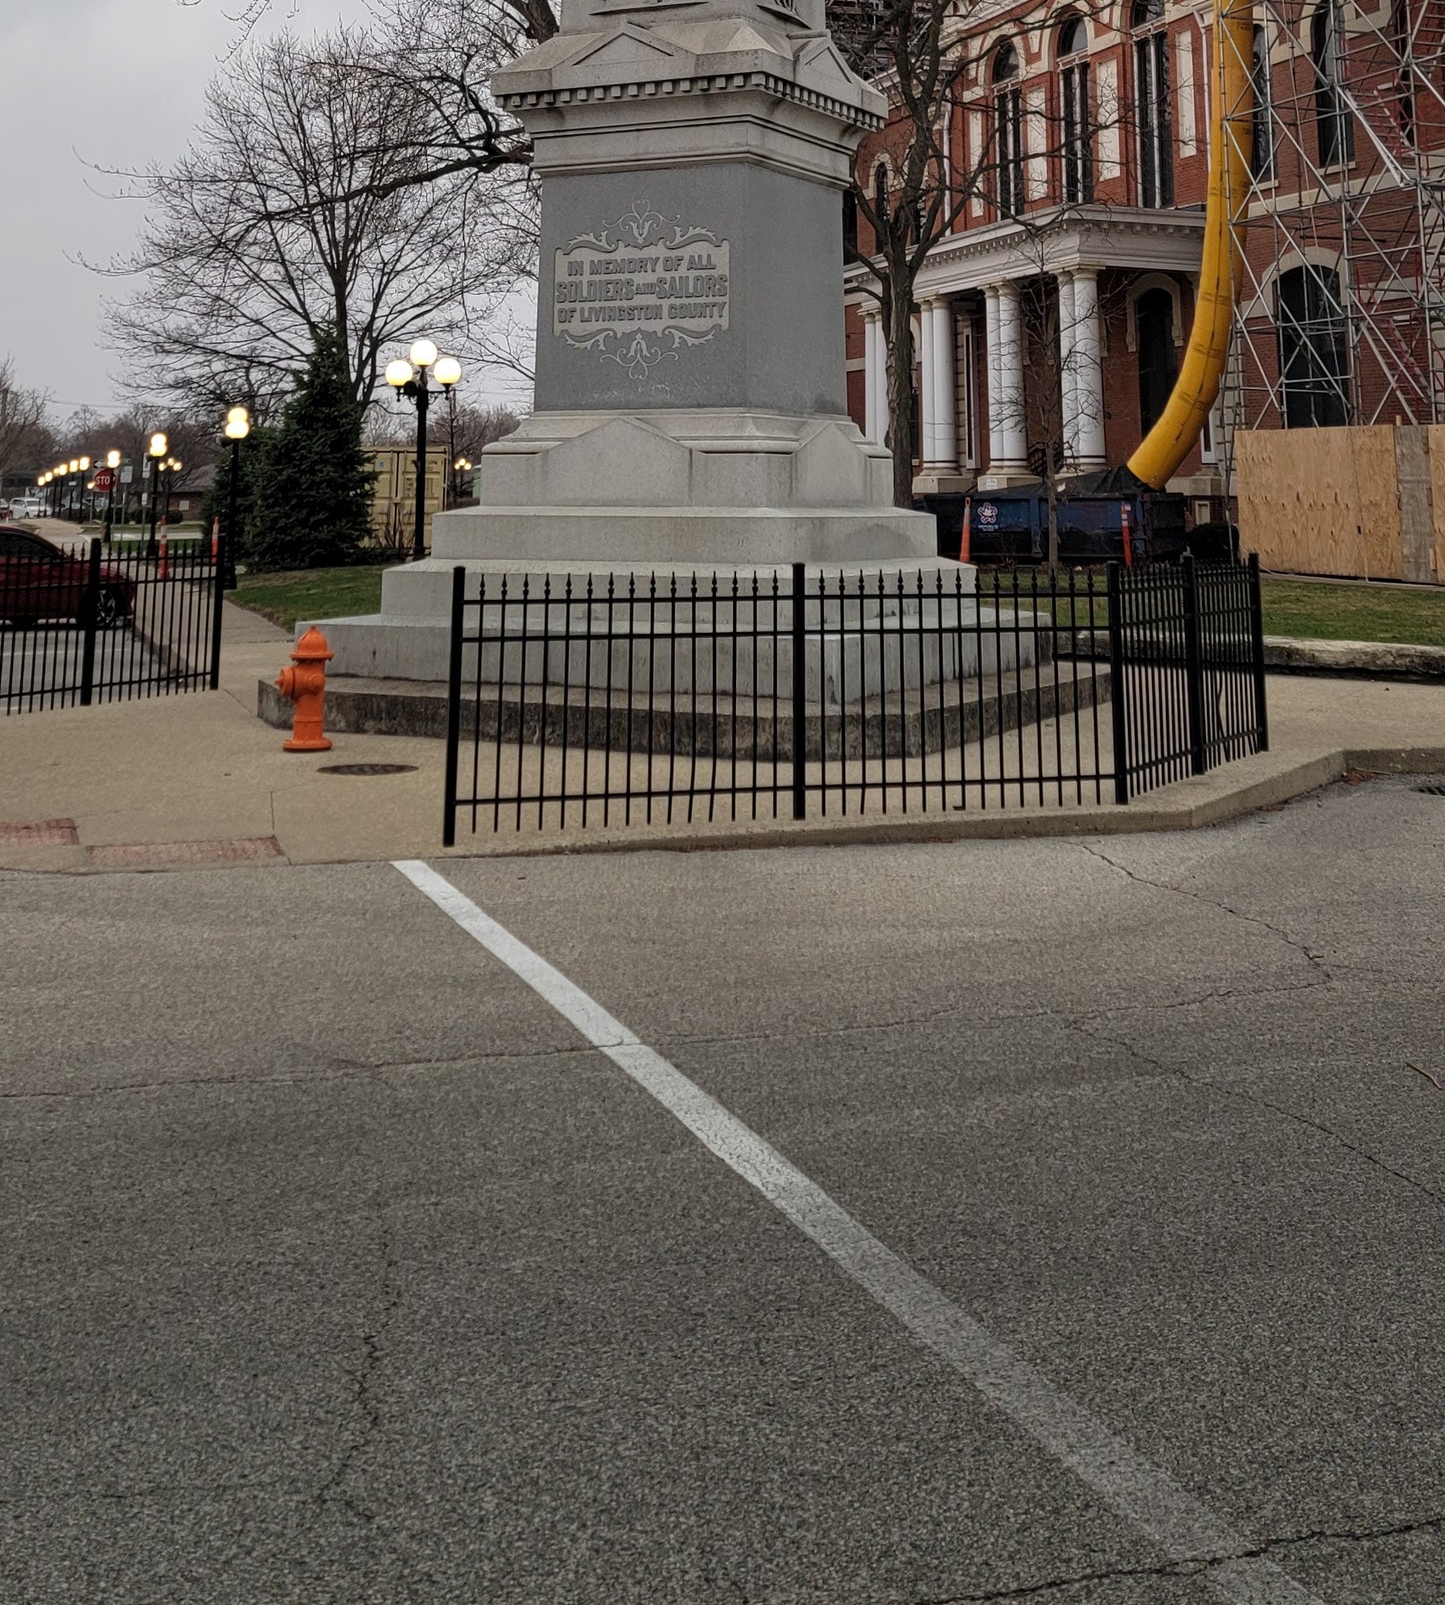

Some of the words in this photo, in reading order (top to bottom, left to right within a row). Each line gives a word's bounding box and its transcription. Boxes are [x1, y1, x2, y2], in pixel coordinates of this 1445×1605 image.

[567, 260, 584, 277] IN
[589, 257, 661, 275] MEMORY
[663, 255, 684, 272] OF
[687, 254, 717, 270] ALL
[556, 278, 635, 304] SOLDIERS
[635, 282, 656, 295] AND
[656, 274, 728, 300] SAILORS
[558, 307, 577, 324] OF
[580, 303, 663, 323] LIVINGSTON
[667, 301, 728, 320] COUNTY
